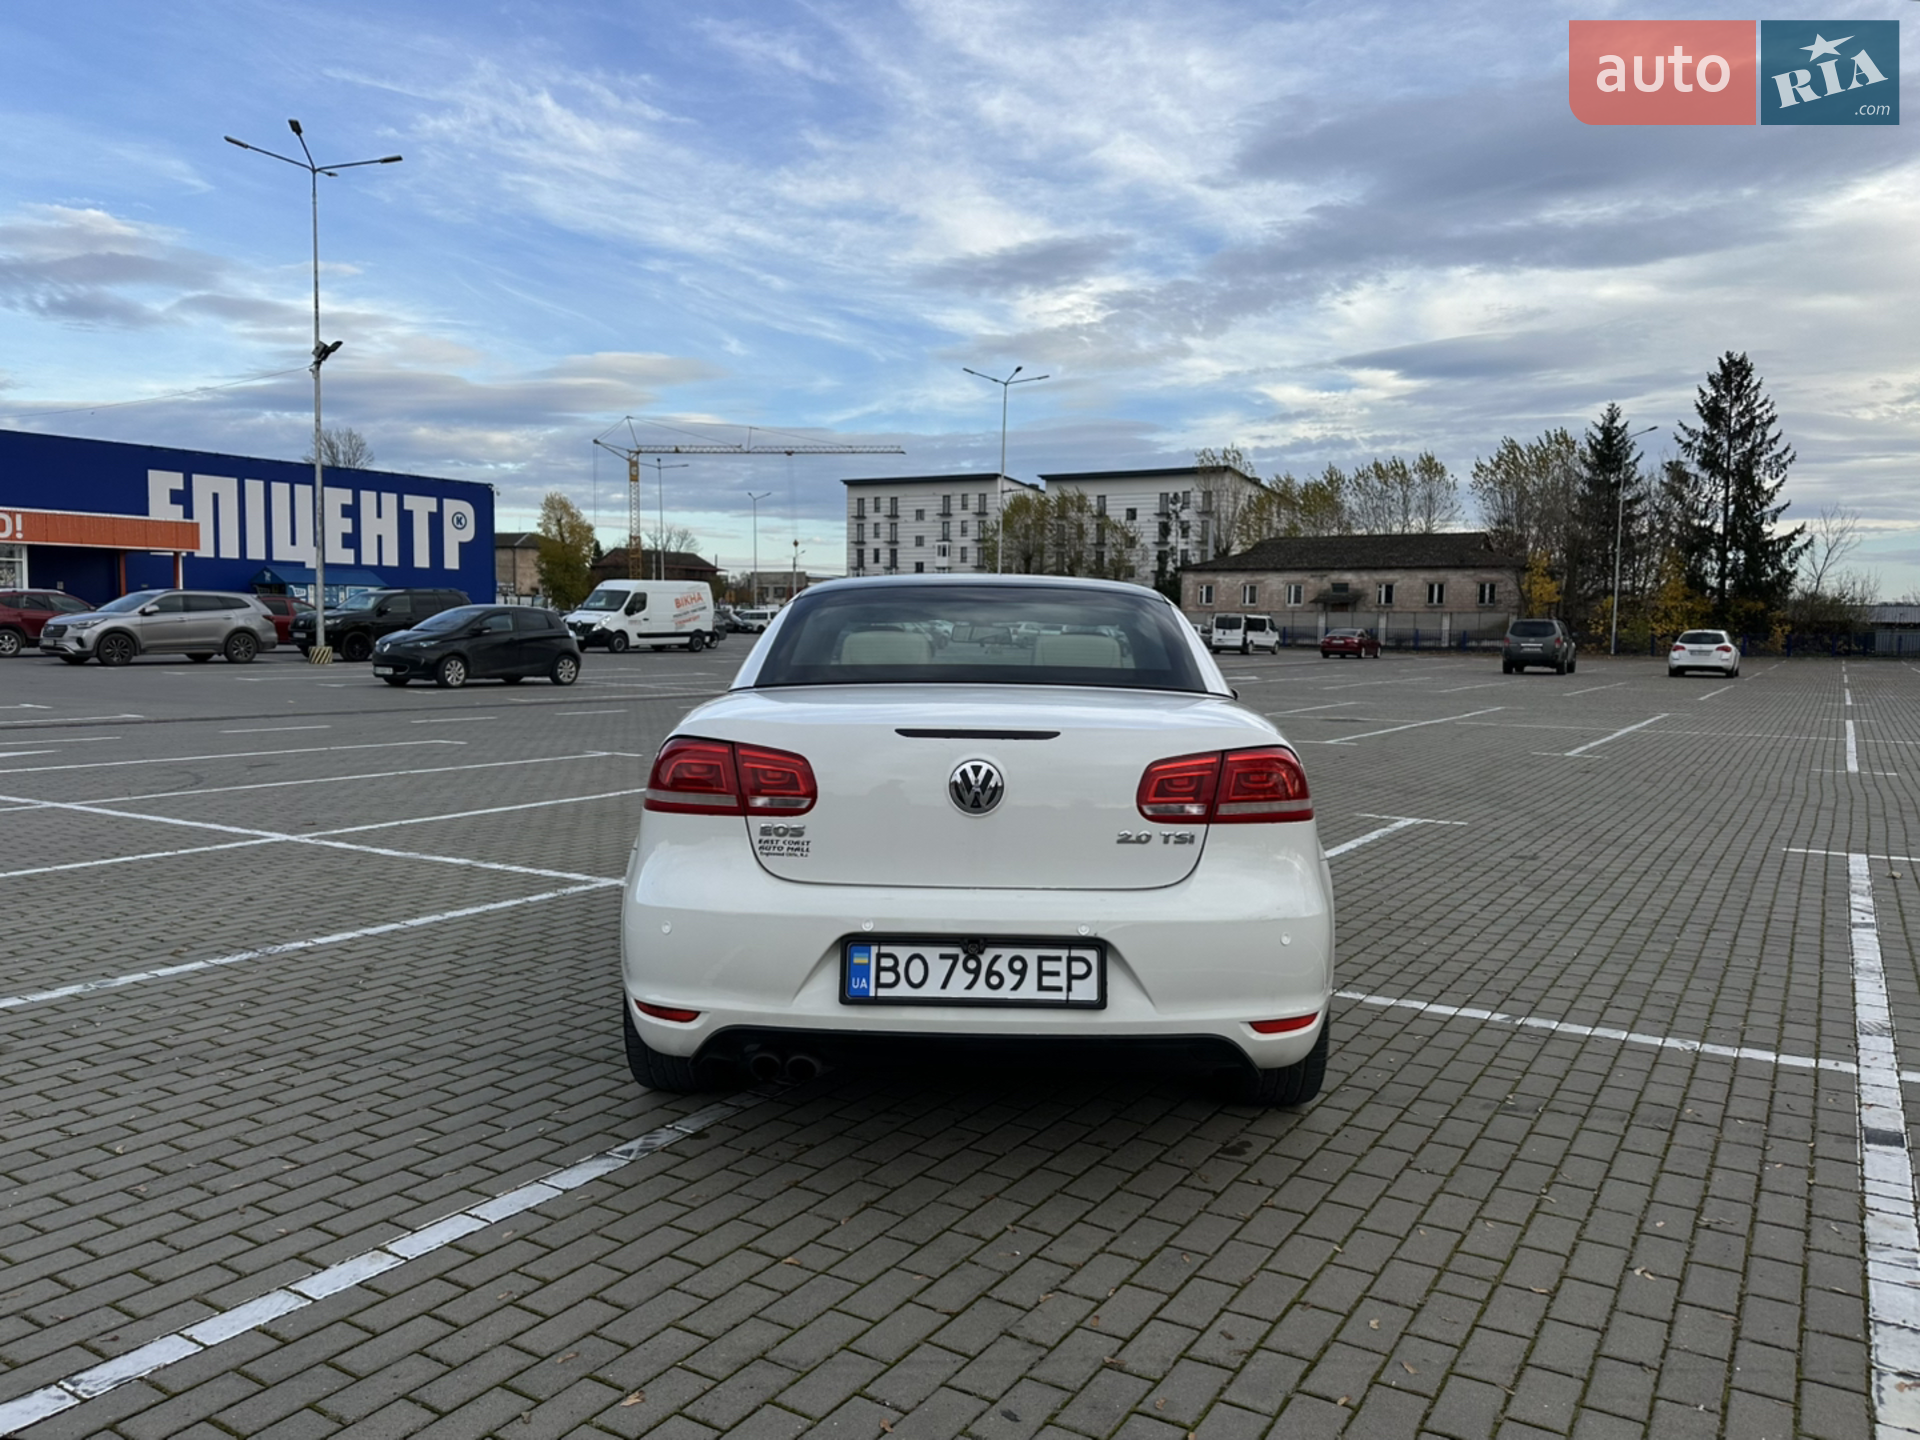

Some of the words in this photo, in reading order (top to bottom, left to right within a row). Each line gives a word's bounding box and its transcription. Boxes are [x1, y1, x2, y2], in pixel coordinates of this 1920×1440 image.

[147, 469, 476, 570] ЕПІЦЕНТР
[759, 823, 806, 838] EOS
[851, 977, 868, 990] UA
